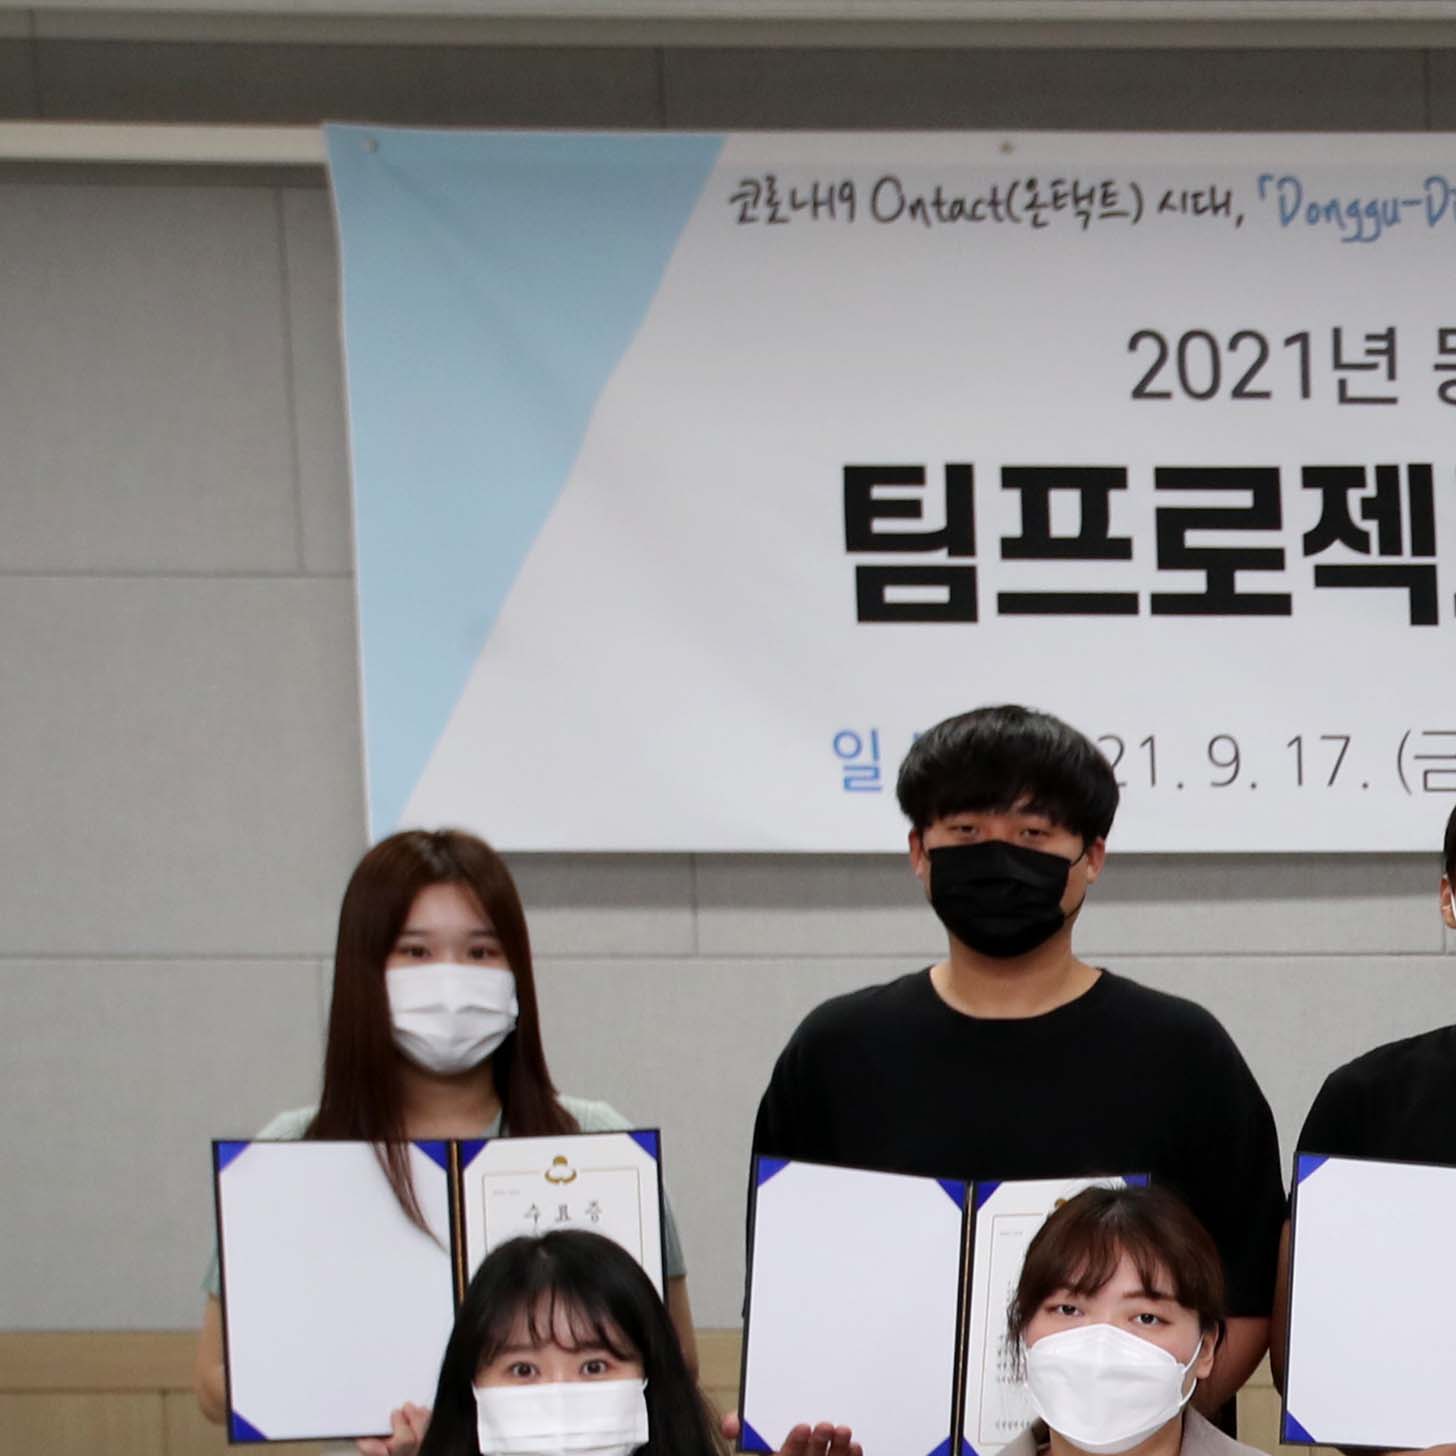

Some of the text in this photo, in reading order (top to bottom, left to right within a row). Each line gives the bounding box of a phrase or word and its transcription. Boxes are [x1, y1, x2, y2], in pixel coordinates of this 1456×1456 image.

[1156, 183, 1245, 229] 시대,
[1126, 324, 1400, 407] 2021년
[1287, 734, 1369, 788] 17.
